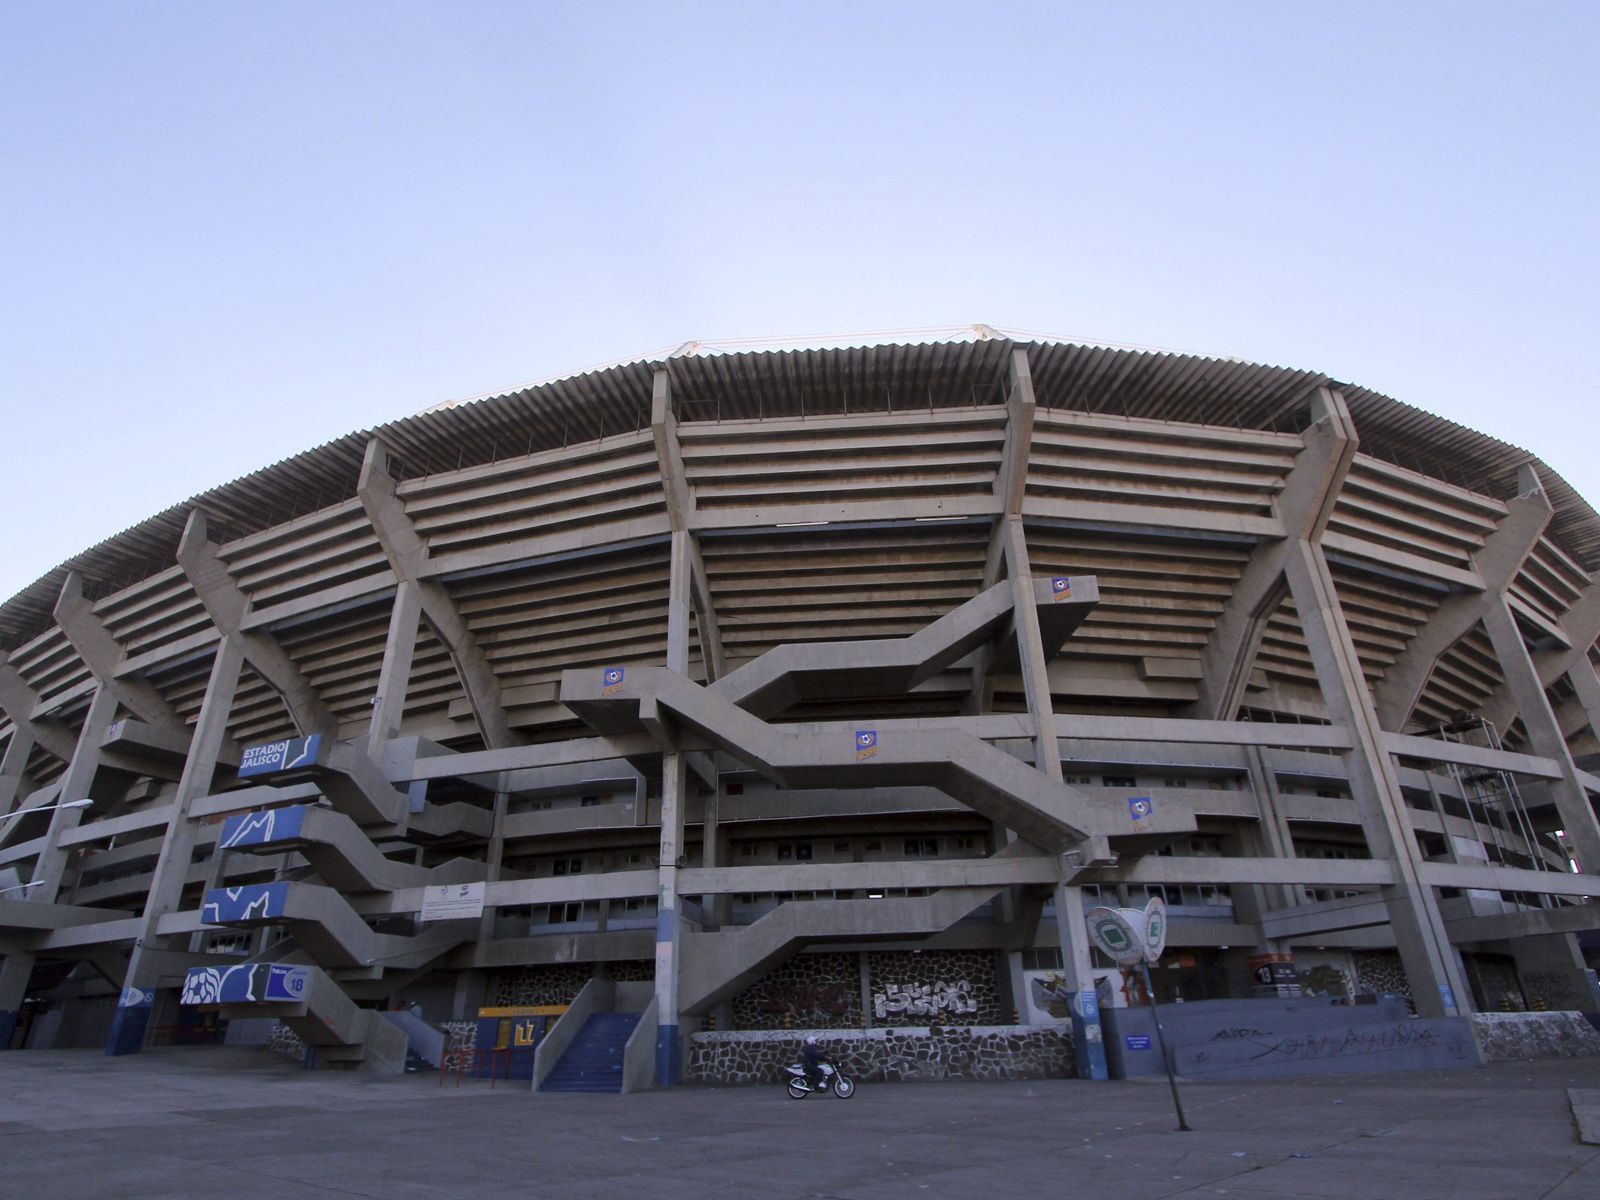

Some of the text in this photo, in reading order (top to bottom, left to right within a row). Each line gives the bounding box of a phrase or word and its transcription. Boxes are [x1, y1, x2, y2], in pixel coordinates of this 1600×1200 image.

[243, 742, 285, 759] ESTADIO
[240, 753, 280, 769] JALISCO
[291, 978, 304, 992] 18
